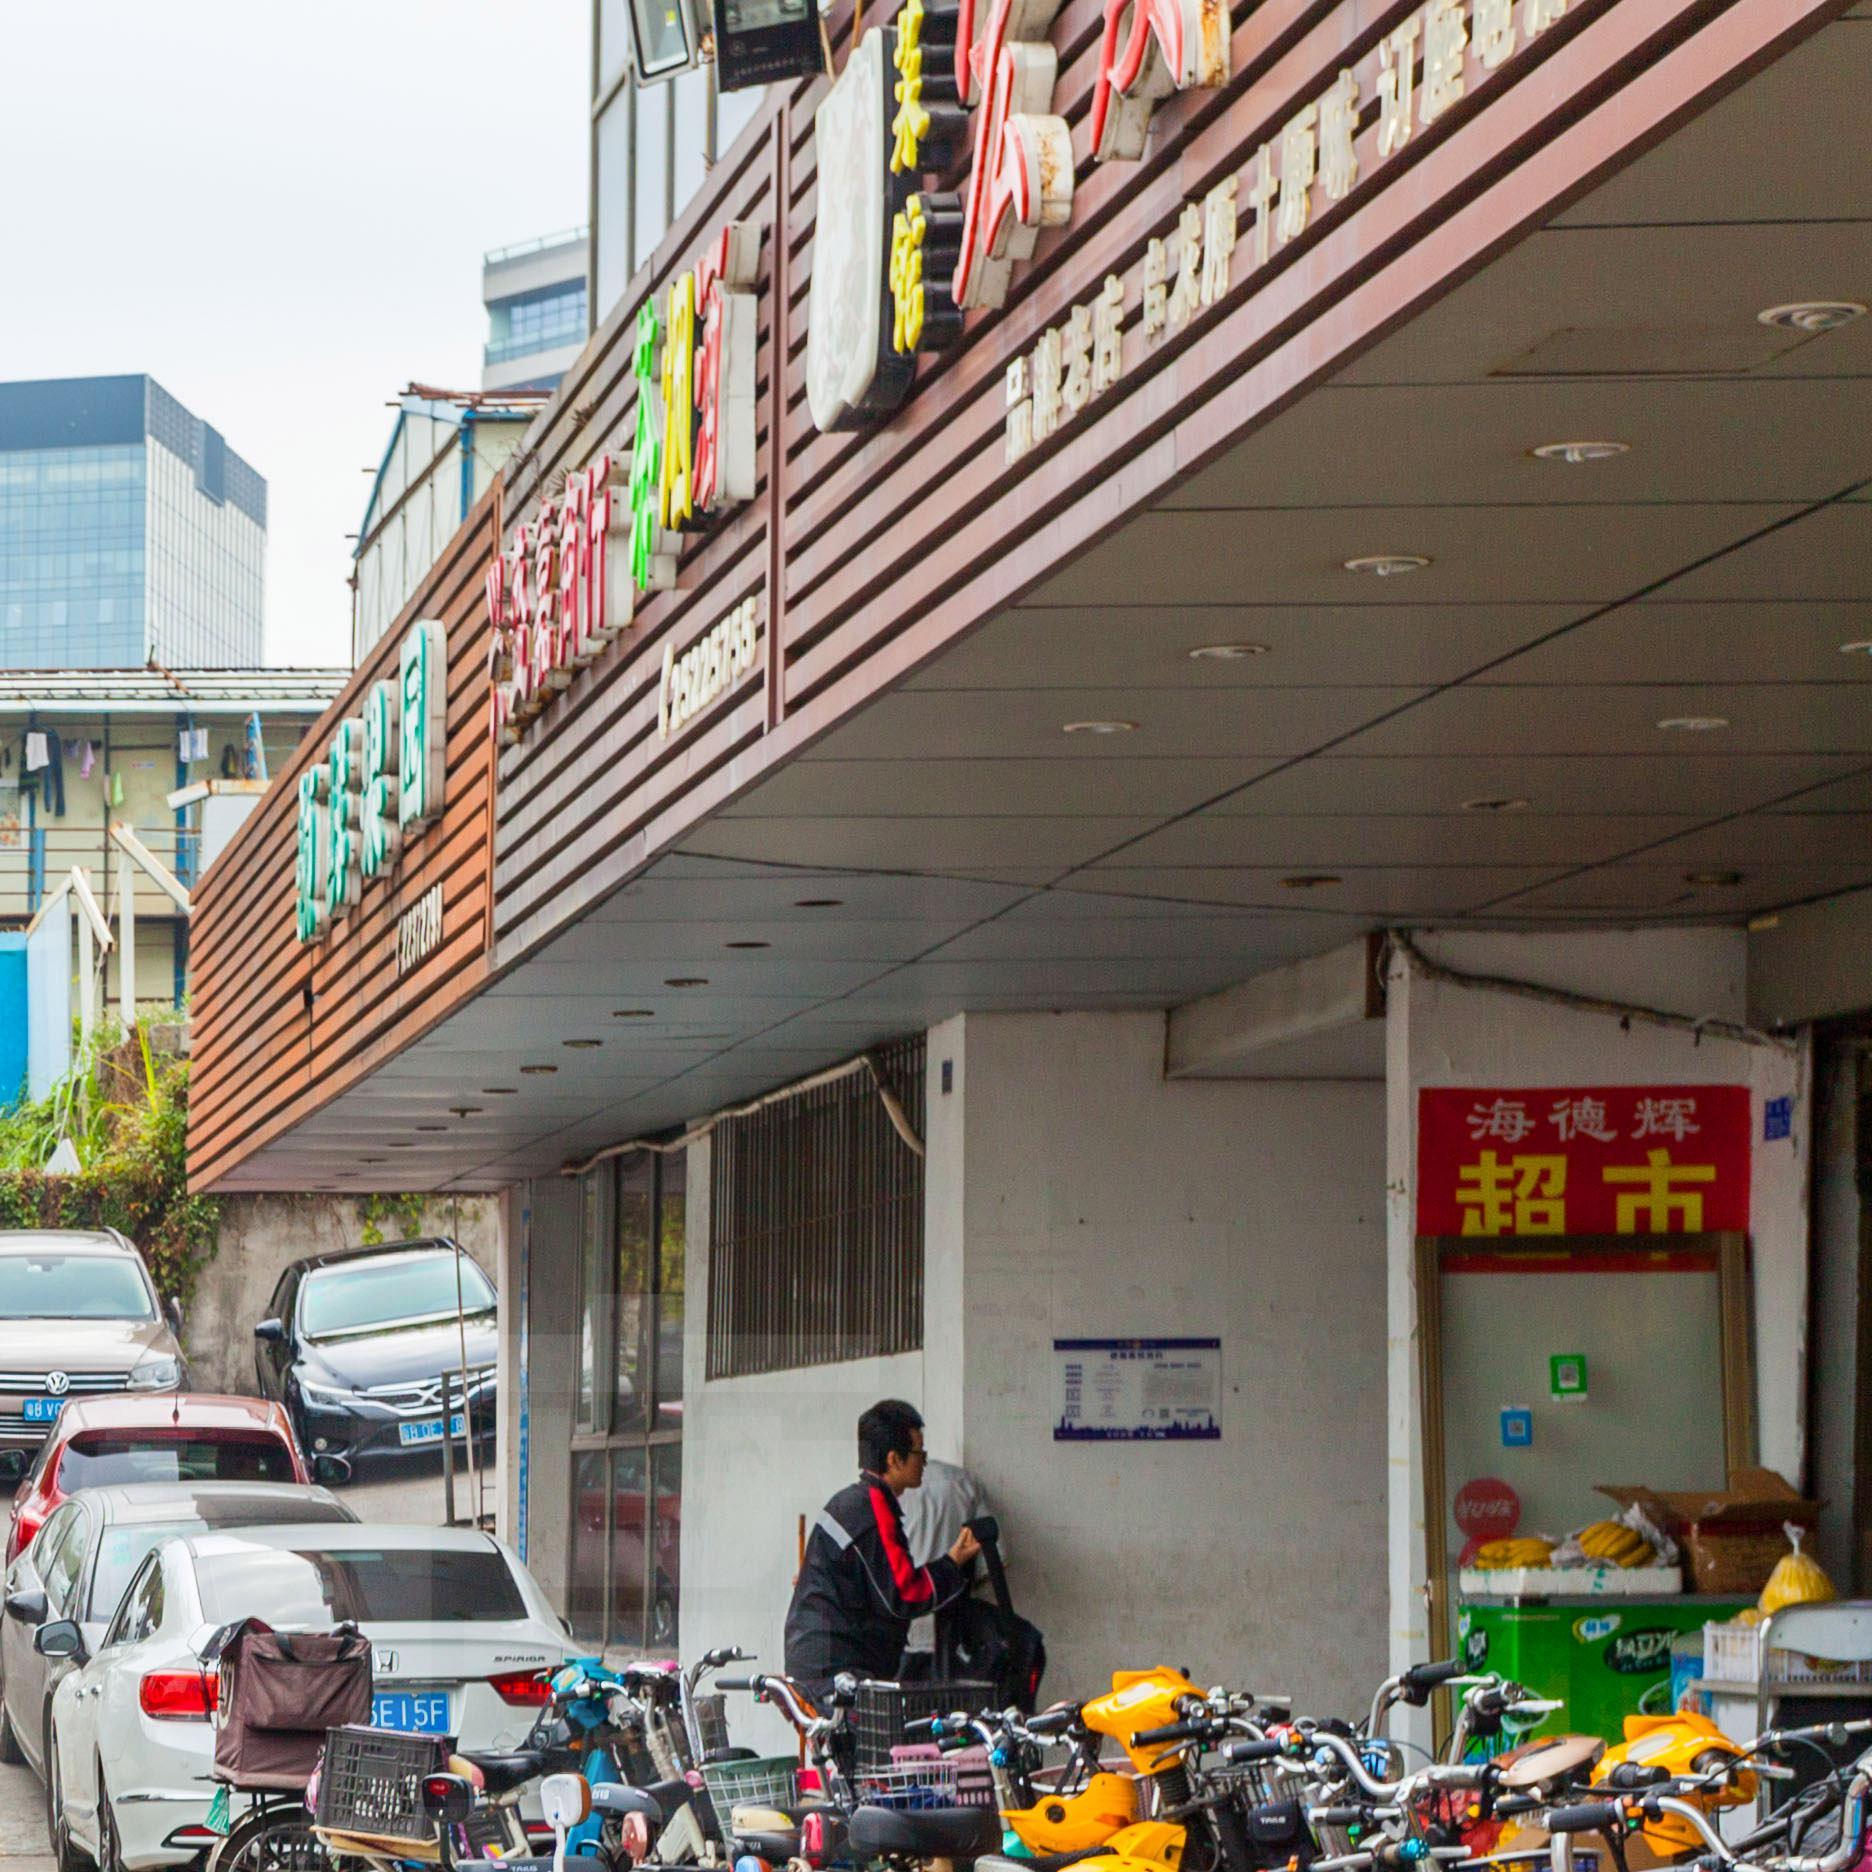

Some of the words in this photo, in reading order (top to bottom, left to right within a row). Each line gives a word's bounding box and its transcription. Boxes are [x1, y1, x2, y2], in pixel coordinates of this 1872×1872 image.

[1466, 1096, 1700, 1143] 海德辉
[1456, 1148, 1716, 1260] 超市
